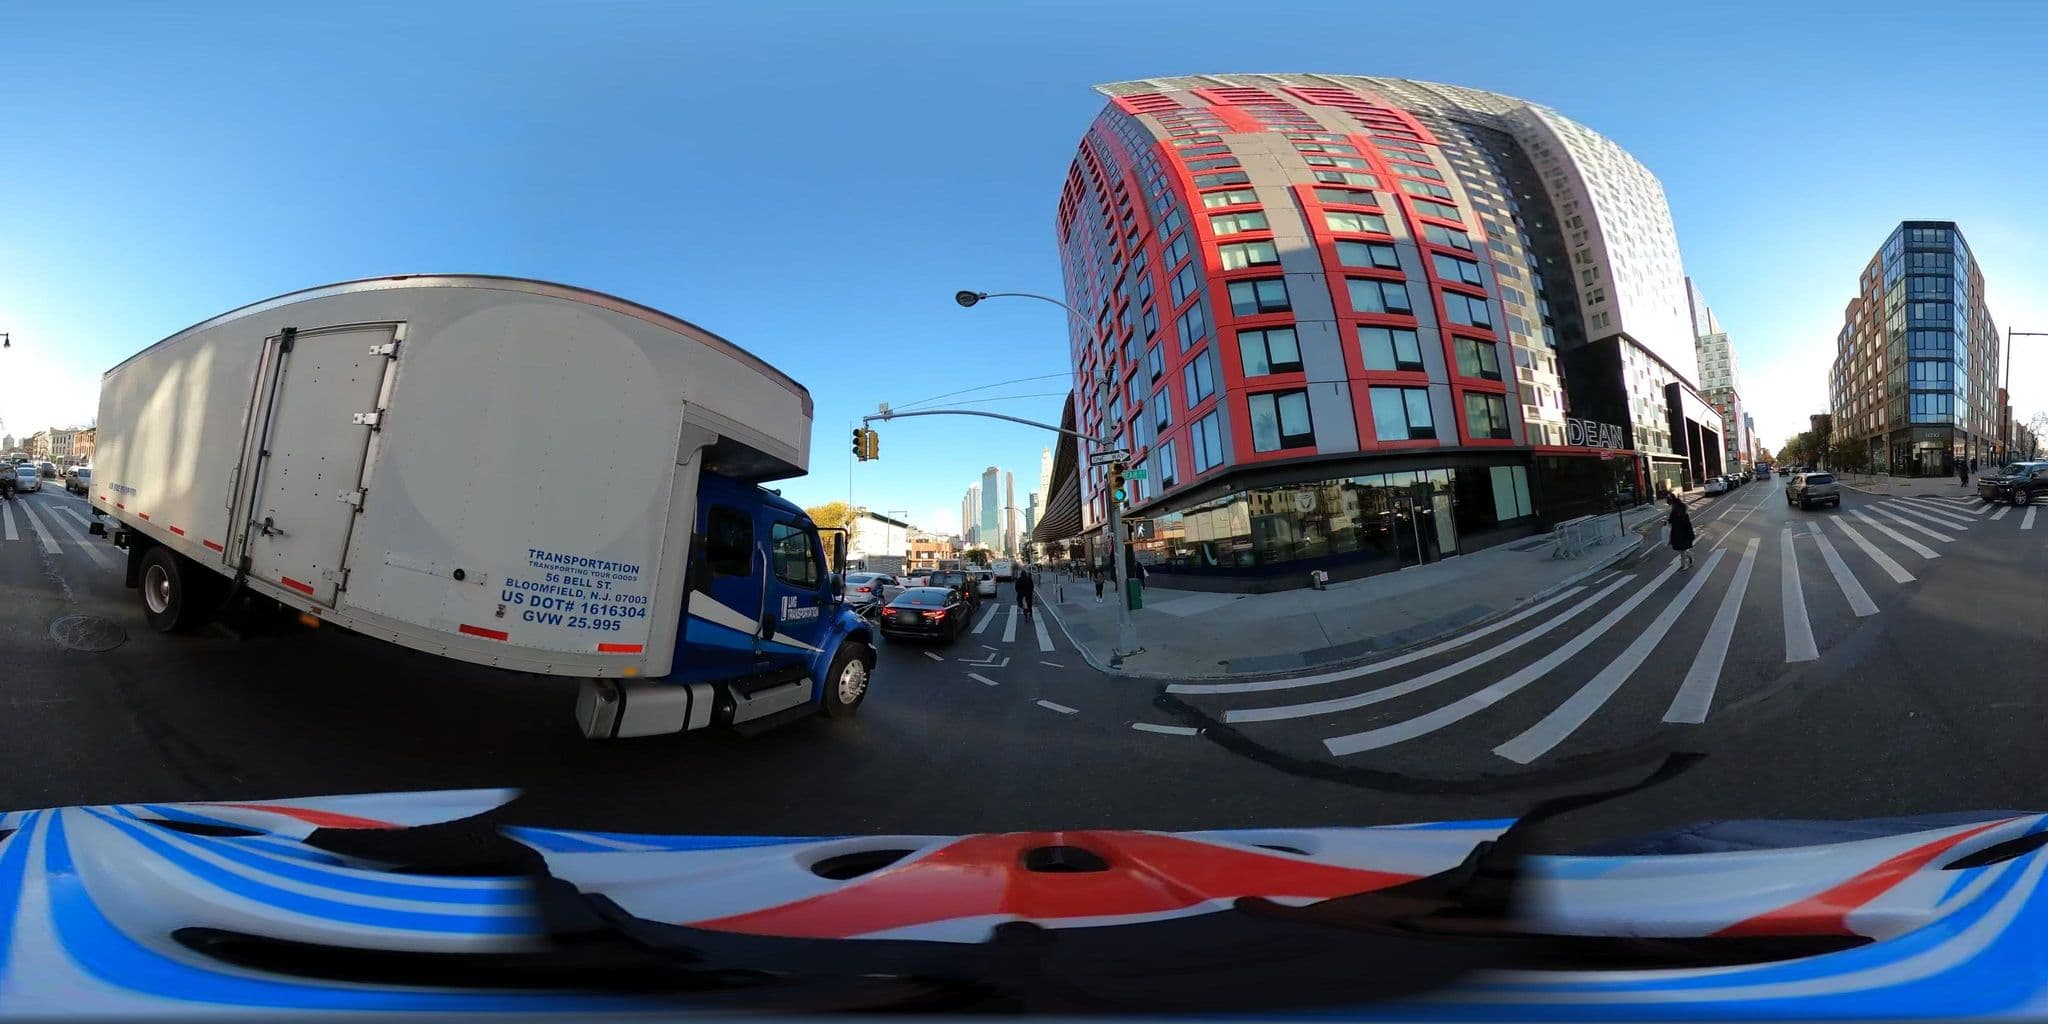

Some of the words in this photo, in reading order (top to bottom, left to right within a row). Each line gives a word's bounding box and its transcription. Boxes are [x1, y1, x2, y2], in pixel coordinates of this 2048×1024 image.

[1567, 417, 1624, 449] DEAN
[528, 548, 640, 574] TRANSPORTATION
[529, 560, 589, 576] TRANSPORTING
[590, 570, 610, 579] YOUR
[612, 573, 637, 582] GOODS
[505, 577, 586, 601] BLOOMFIELD,
[590, 591, 611, 601] N.J.
[615, 594, 647, 604] 07003
[545, 572, 560, 583] 56
[563, 575, 592, 588] BELL
[596, 580, 612, 590] ST.
[501, 589, 524, 605] US
[530, 594, 575, 612] DOT#
[580, 602, 646, 618] 1616304
[522, 609, 563, 626] GVW
[567, 616, 621, 631] 25.995
